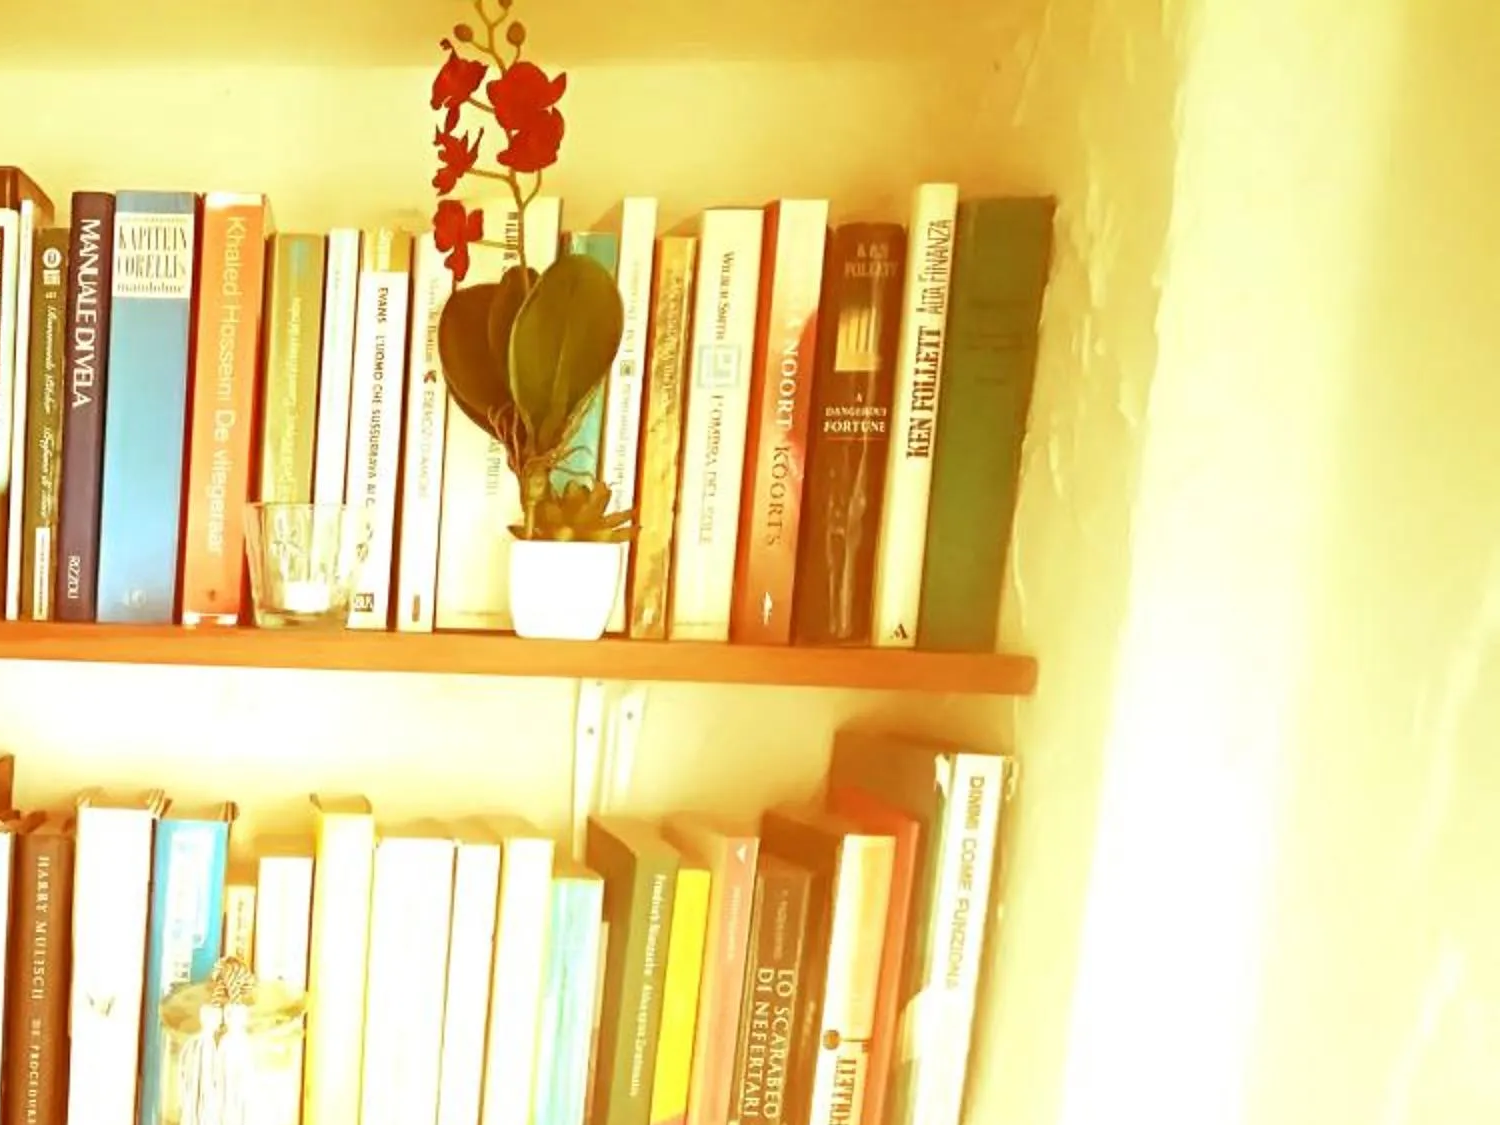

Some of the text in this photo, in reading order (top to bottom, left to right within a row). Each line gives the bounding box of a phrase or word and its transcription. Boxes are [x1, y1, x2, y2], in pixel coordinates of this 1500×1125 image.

[71, 218, 101, 409] MANUALE DI VELA
[375, 287, 388, 324] EVANS
[205, 215, 246, 558] Khaled Hosseini De vliegeraar
[371, 334, 386, 380] L'UOMO
[910, 326, 941, 413] FOLLETT
[370, 383, 384, 405] CHE
[823, 419, 887, 434] FORTUNE
[766, 343, 799, 548] NOORT KOORTS
[906, 418, 932, 460] KEN
[35, 855, 51, 914] HARRY
[957, 837, 978, 891] COME
[30, 920, 48, 1001] MULISCH
[945, 897, 971, 990] FUNZIONA
[776, 968, 795, 998] LO
[743, 967, 774, 1118] DI NEFERTARI
[763, 1006, 792, 1119] SCARABEO
